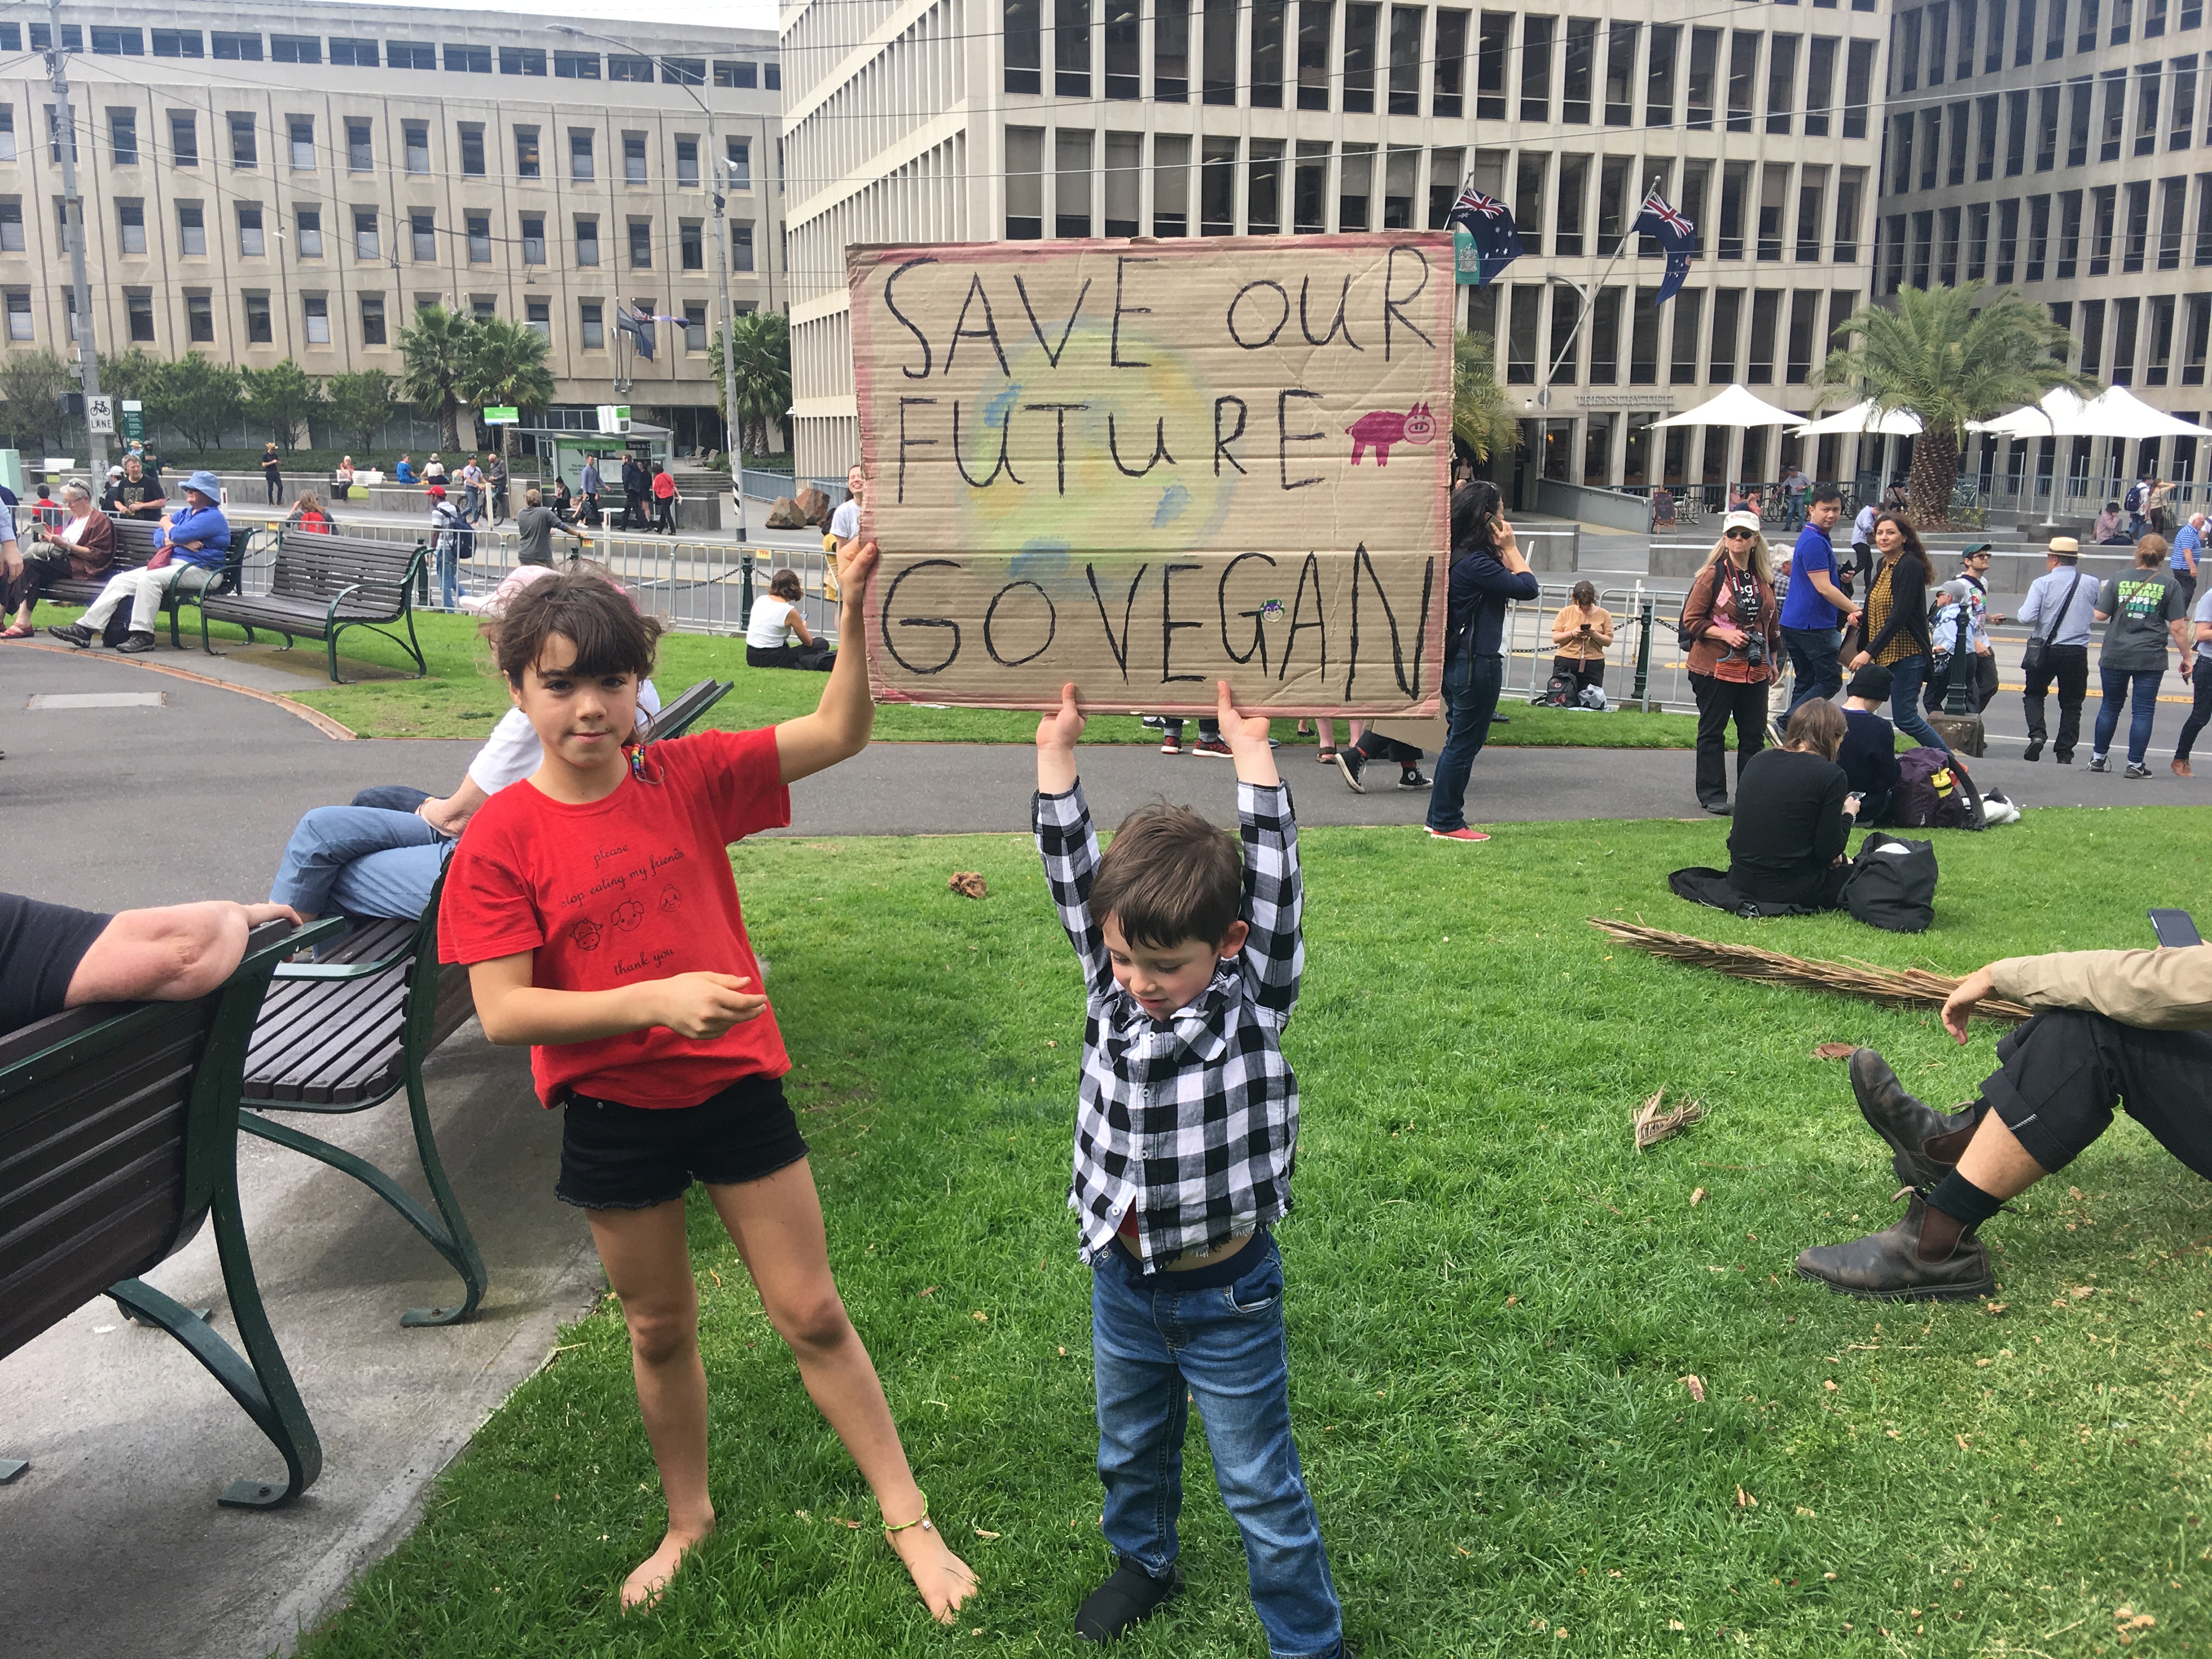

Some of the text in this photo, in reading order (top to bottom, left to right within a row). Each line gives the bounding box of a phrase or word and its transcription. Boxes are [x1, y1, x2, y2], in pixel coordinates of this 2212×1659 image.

[884, 245, 1437, 379] SAVE OUR
[1576, 395, 1641, 406] TREASURY
[91, 419, 112, 428] LANE
[898, 388, 1326, 504] FUTURE
[2118, 588, 2164, 600] DAMAGE
[2119, 580, 2165, 593] CLIMATE
[2118, 595, 2150, 605] STOPS
[881, 541, 1435, 703] GO VEGAN
[592, 844, 629, 869] please
[561, 847, 685, 909] stop eating my friends
[613, 946, 674, 976] thank you
